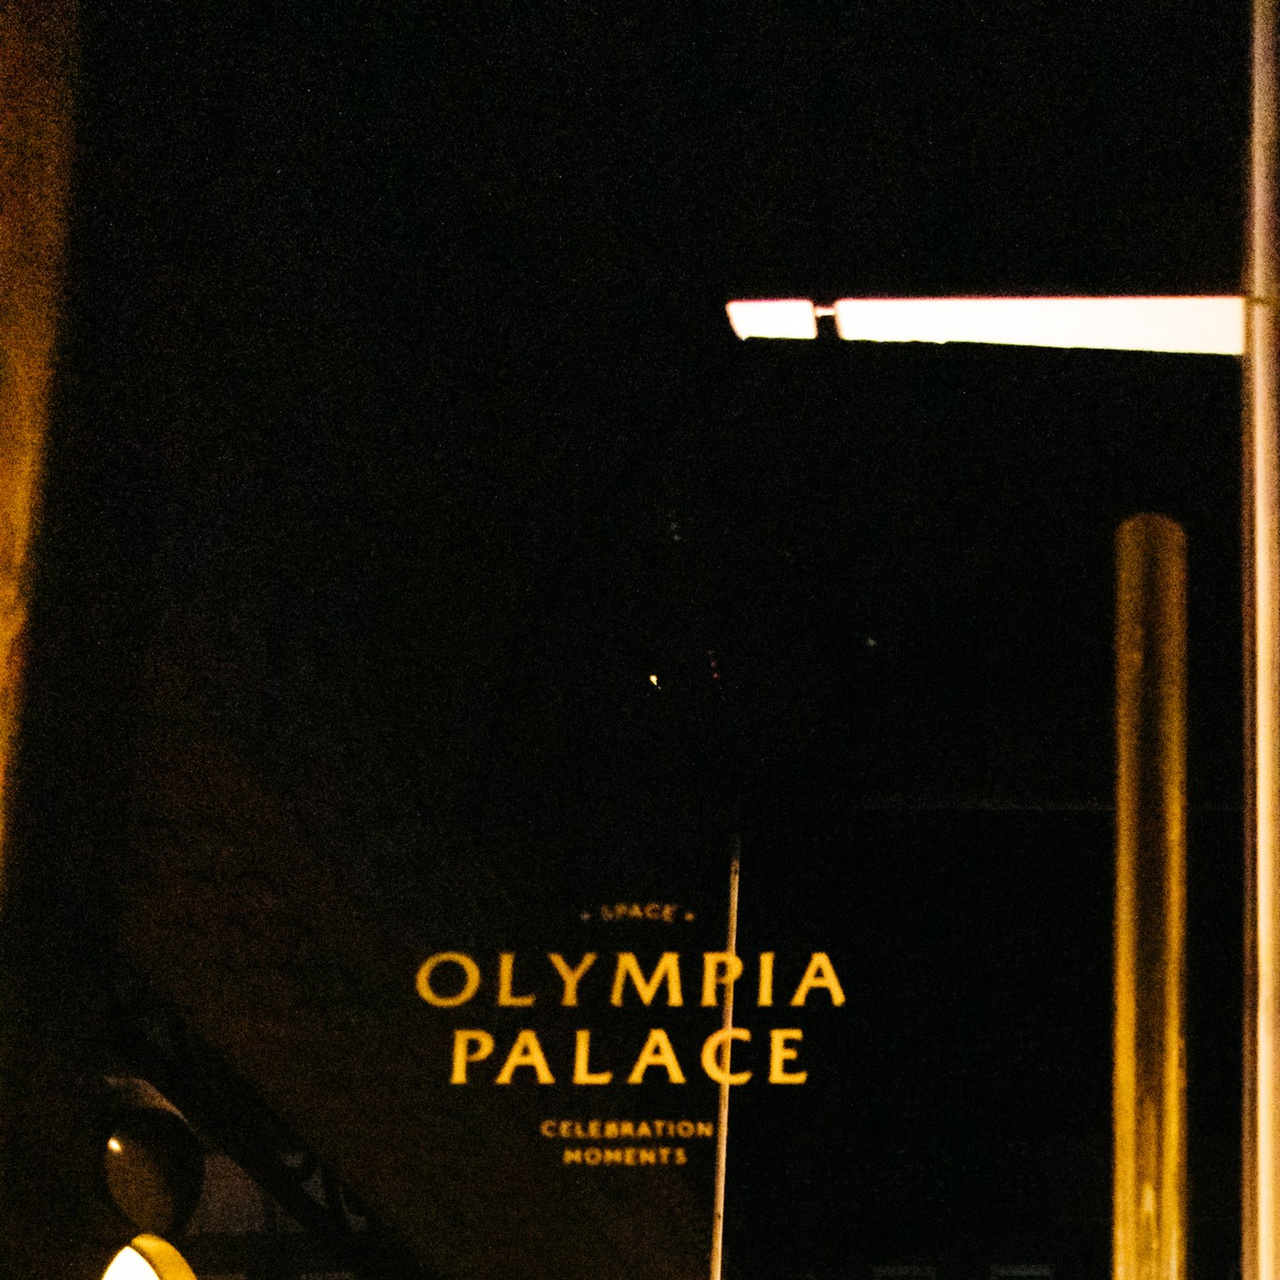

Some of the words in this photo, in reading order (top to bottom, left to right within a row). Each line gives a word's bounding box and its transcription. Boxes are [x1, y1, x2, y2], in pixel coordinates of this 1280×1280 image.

[601, 902, 677, 922] SPACE
[415, 951, 846, 1008] OLYMPIA
[450, 1028, 808, 1086] PALACE
[540, 1119, 714, 1139] CELEBRATION
[563, 1147, 688, 1167] MOMENTS
